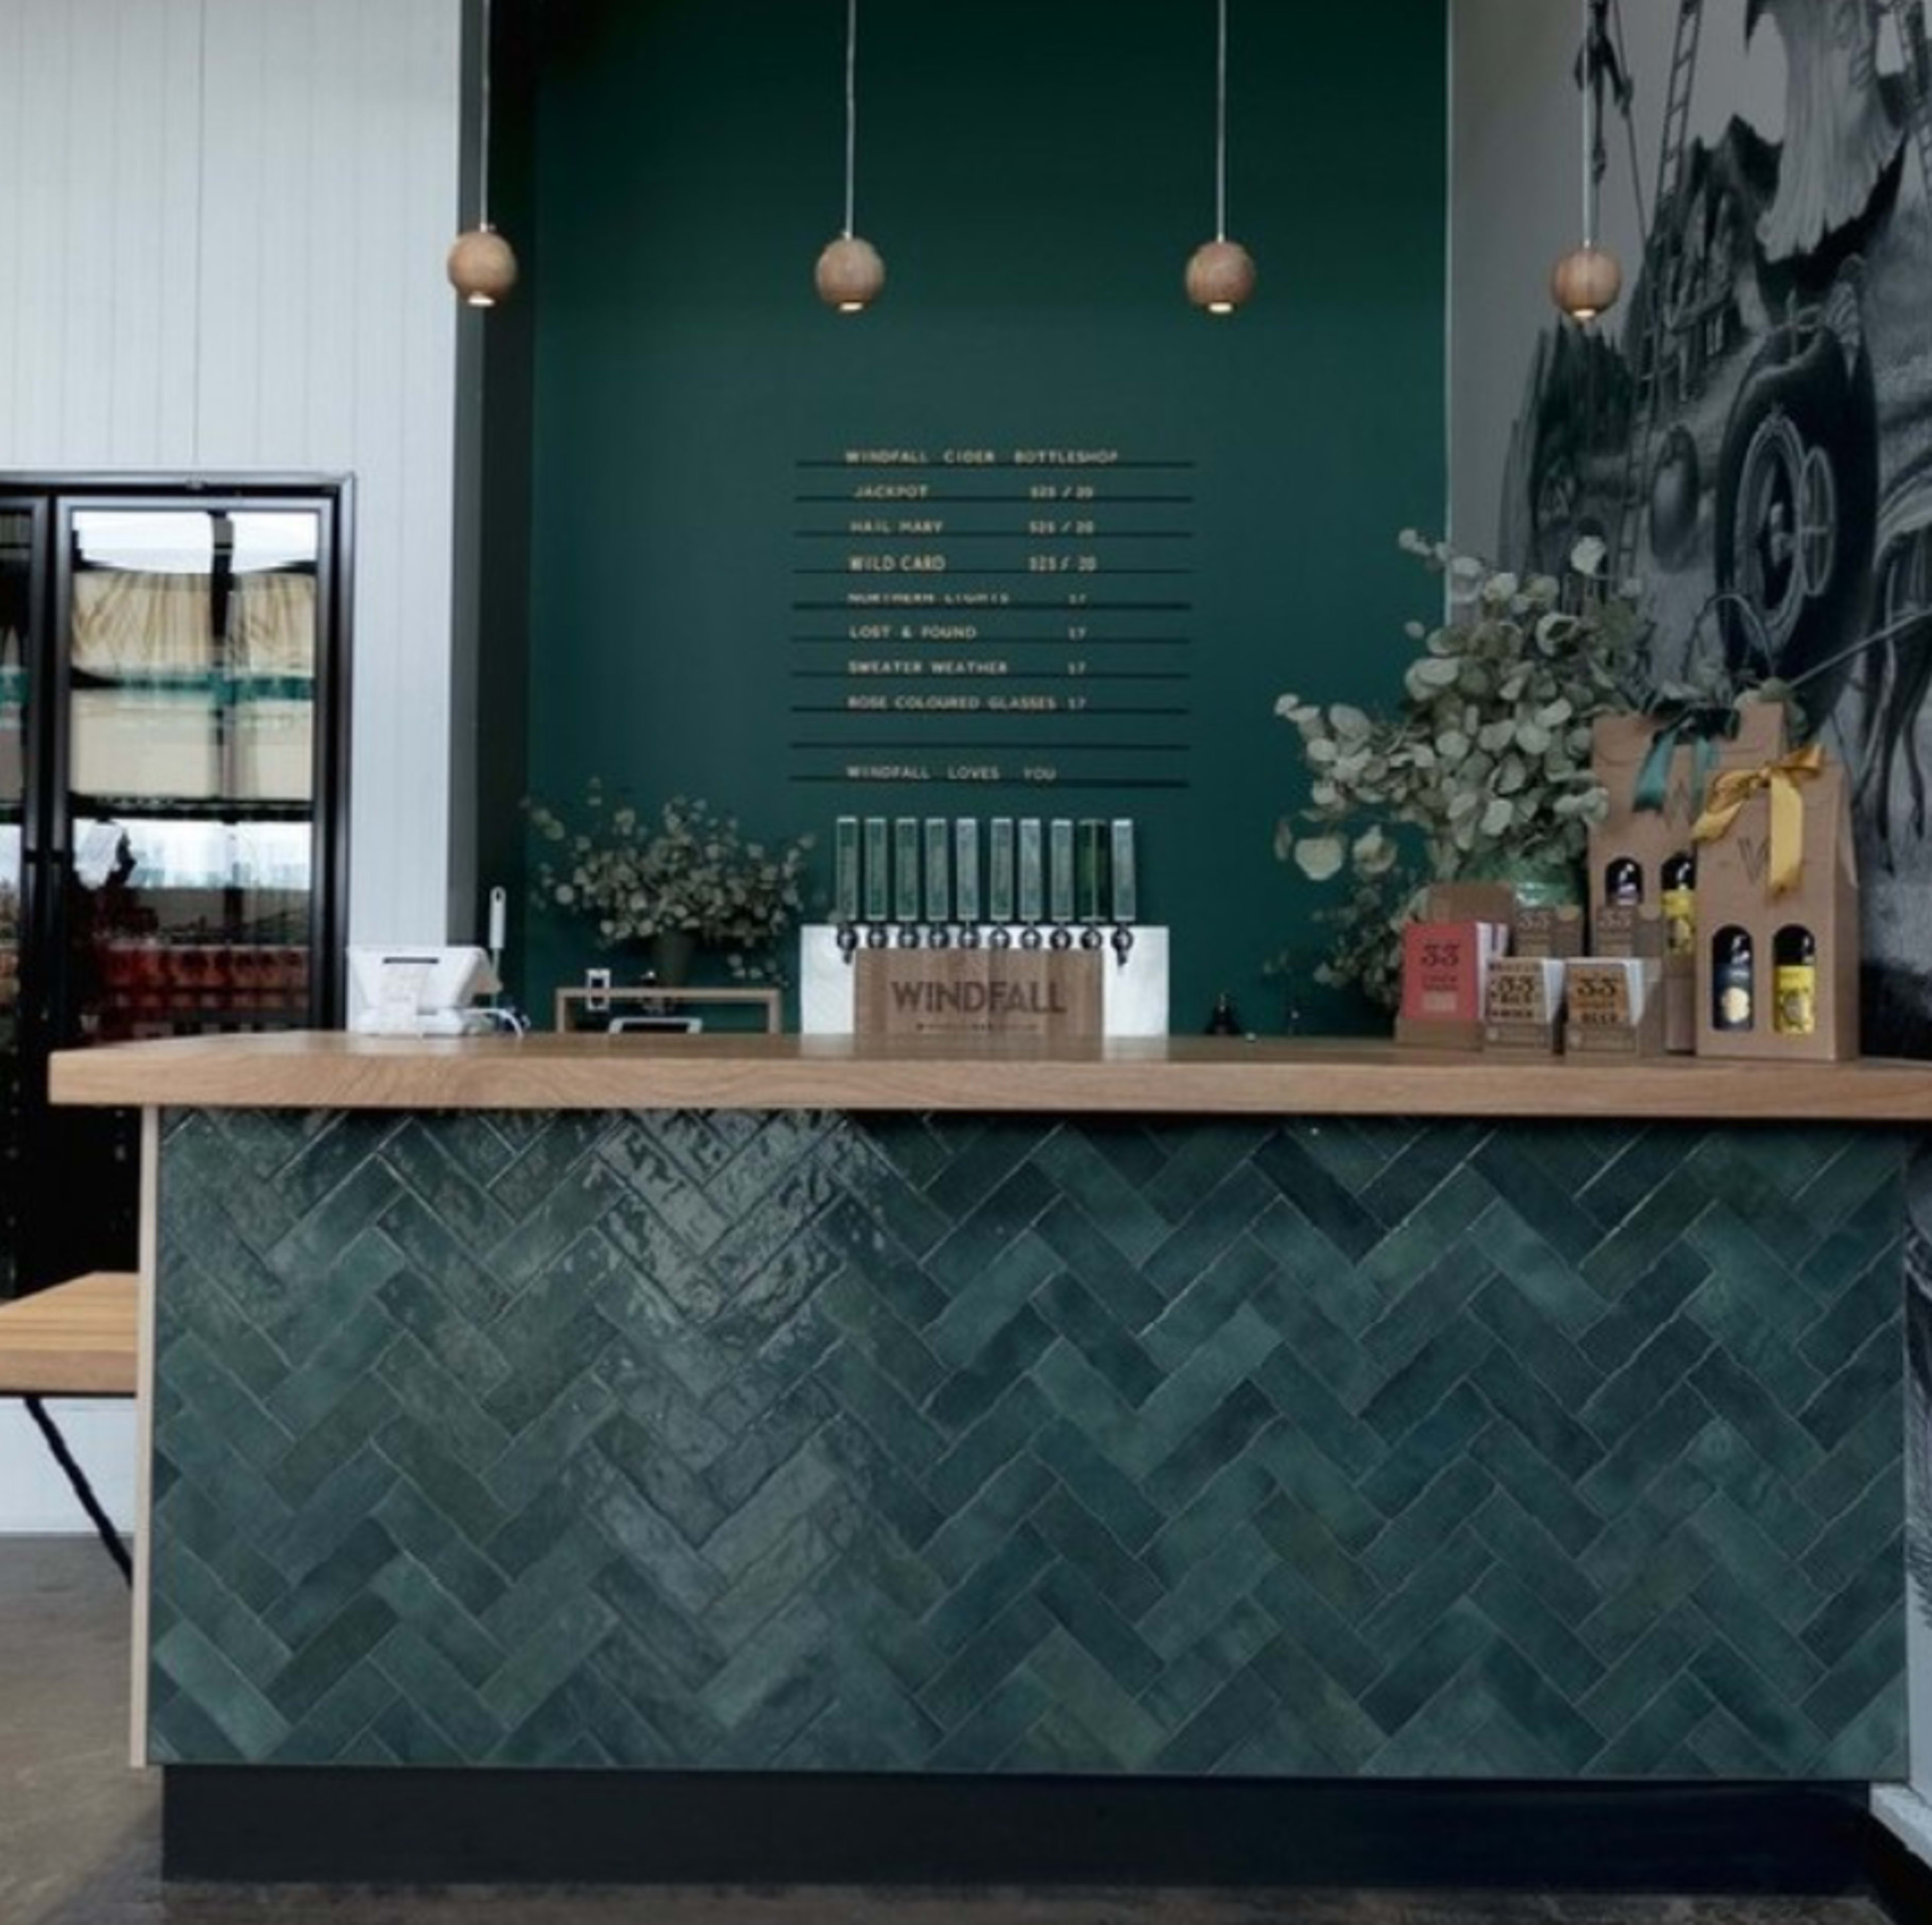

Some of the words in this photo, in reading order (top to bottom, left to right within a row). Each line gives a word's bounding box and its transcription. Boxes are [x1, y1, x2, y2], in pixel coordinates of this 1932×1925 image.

[845, 450, 926, 463] WINDFALL
[943, 450, 995, 463] CIDER
[1014, 450, 1118, 463] BOTTLESHOP
[855, 484, 928, 497] JACKPOT
[850, 521, 890, 533] HAIL
[900, 521, 942, 532] MARY
[850, 555, 895, 571] WILD
[901, 555, 945, 571] CARD
[849, 625, 891, 638] LOST
[901, 626, 912, 638] &
[921, 625, 977, 638] FOUND
[849, 660, 922, 673] SWEATER
[931, 661, 1007, 674] WEATHER
[848, 695, 886, 708] ROSE
[894, 696, 980, 709] COLOURED
[988, 697, 1056, 709] GLASSES
[846, 766, 929, 779] WINDFALL
[947, 766, 1000, 779] LOVES
[1023, 767, 1057, 780] YOU
[890, 981, 1068, 1014] WINDFALL
